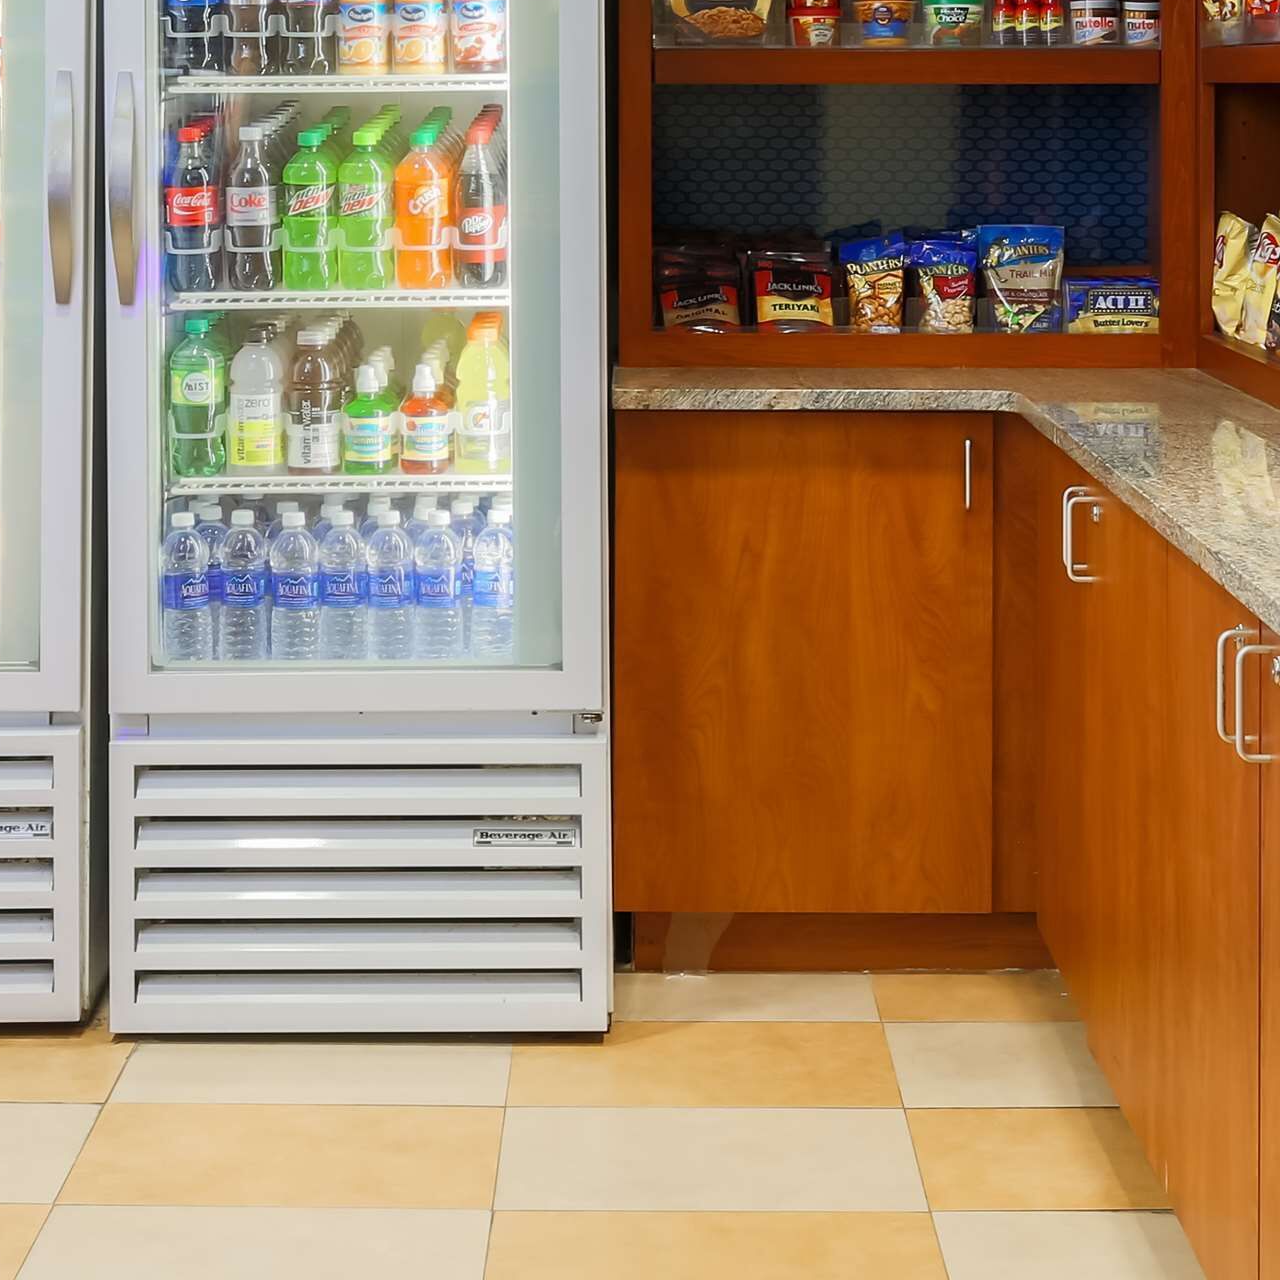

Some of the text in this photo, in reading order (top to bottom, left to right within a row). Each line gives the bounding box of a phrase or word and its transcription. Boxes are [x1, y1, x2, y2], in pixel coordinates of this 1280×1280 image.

[1075, 18, 1114, 31] nutella
[230, 192, 267, 208] Coke
[846, 255, 902, 275] PLANTERS
[766, 282, 792, 293] JACK
[1095, 295, 1146, 309] ACT II
[1121, 319, 1150, 328] Lovers
